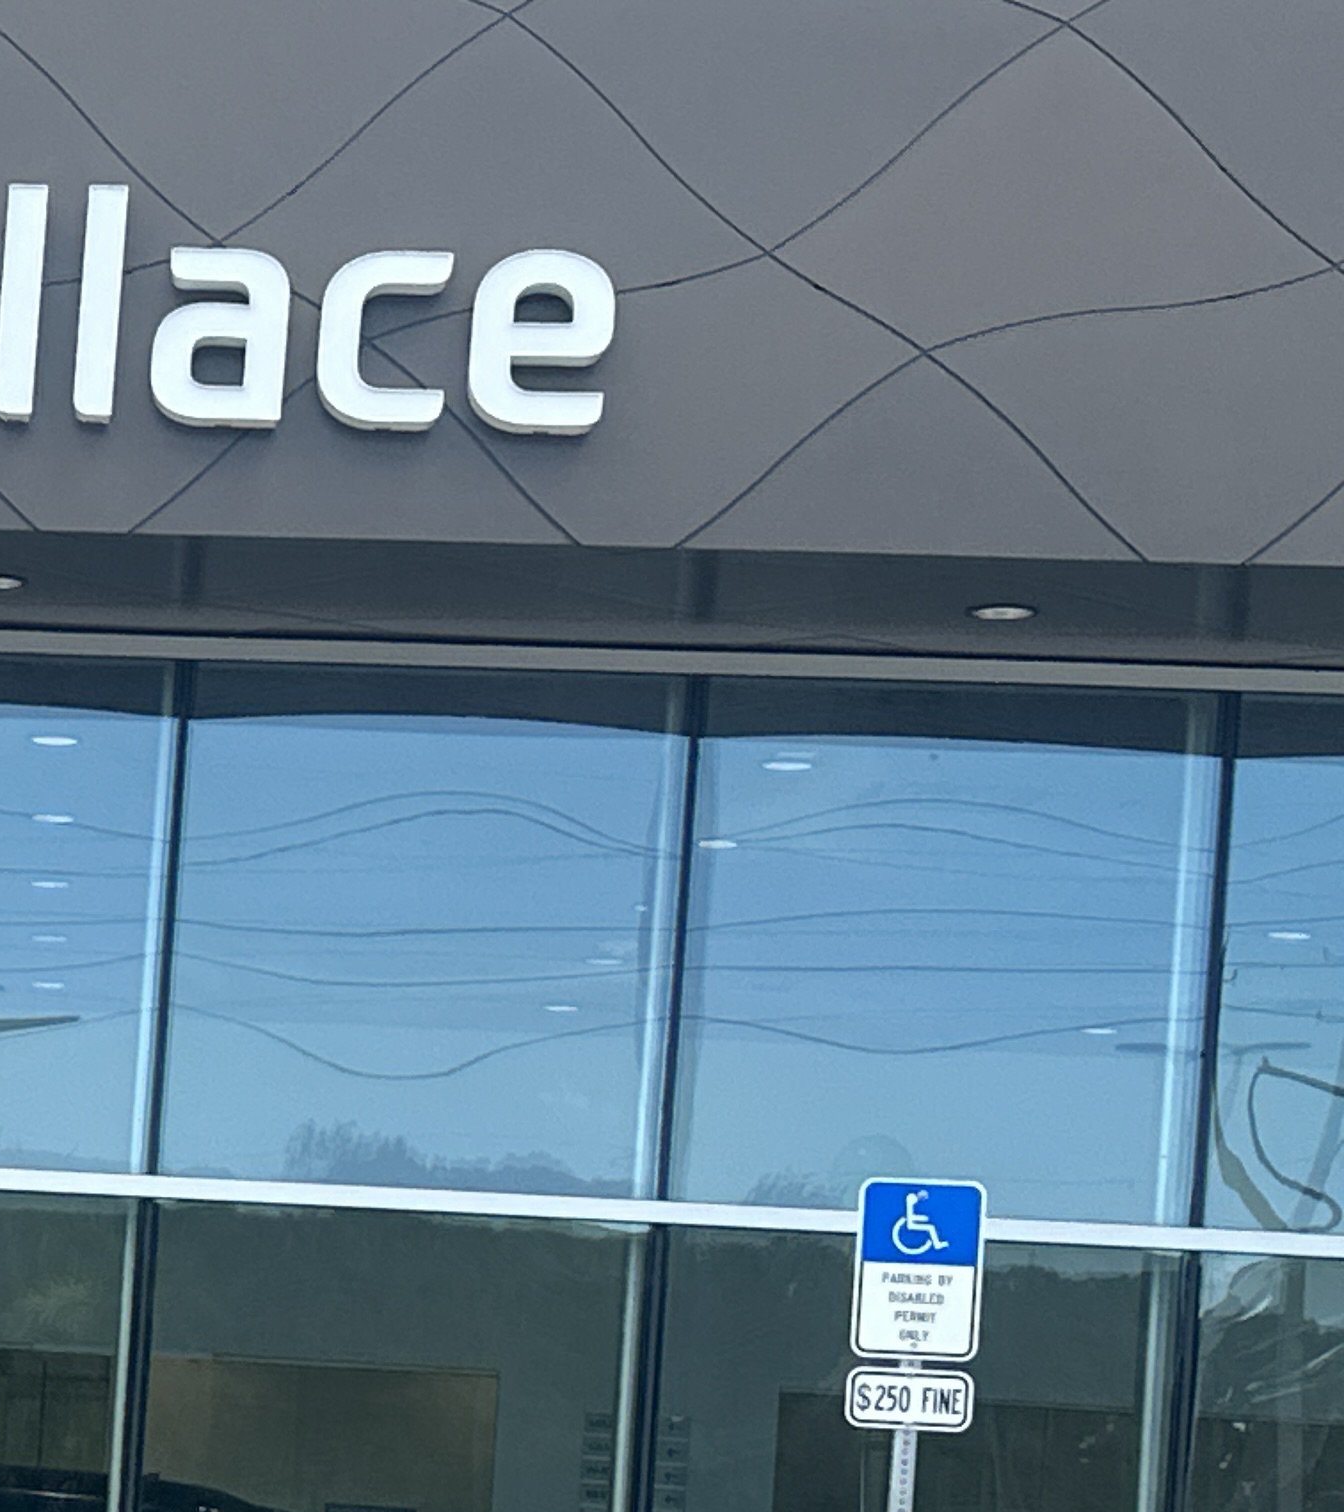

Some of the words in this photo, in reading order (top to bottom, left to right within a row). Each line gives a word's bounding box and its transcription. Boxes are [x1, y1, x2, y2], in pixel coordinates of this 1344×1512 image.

[881, 1271, 933, 1286] PARKING
[938, 1274, 954, 1287] BY
[888, 1290, 945, 1305] DISABLED
[893, 1310, 937, 1324] PERMIT
[898, 1328, 930, 1342] ONLY
[855, 1382, 912, 1412] $250
[920, 1386, 963, 1415] FINE
